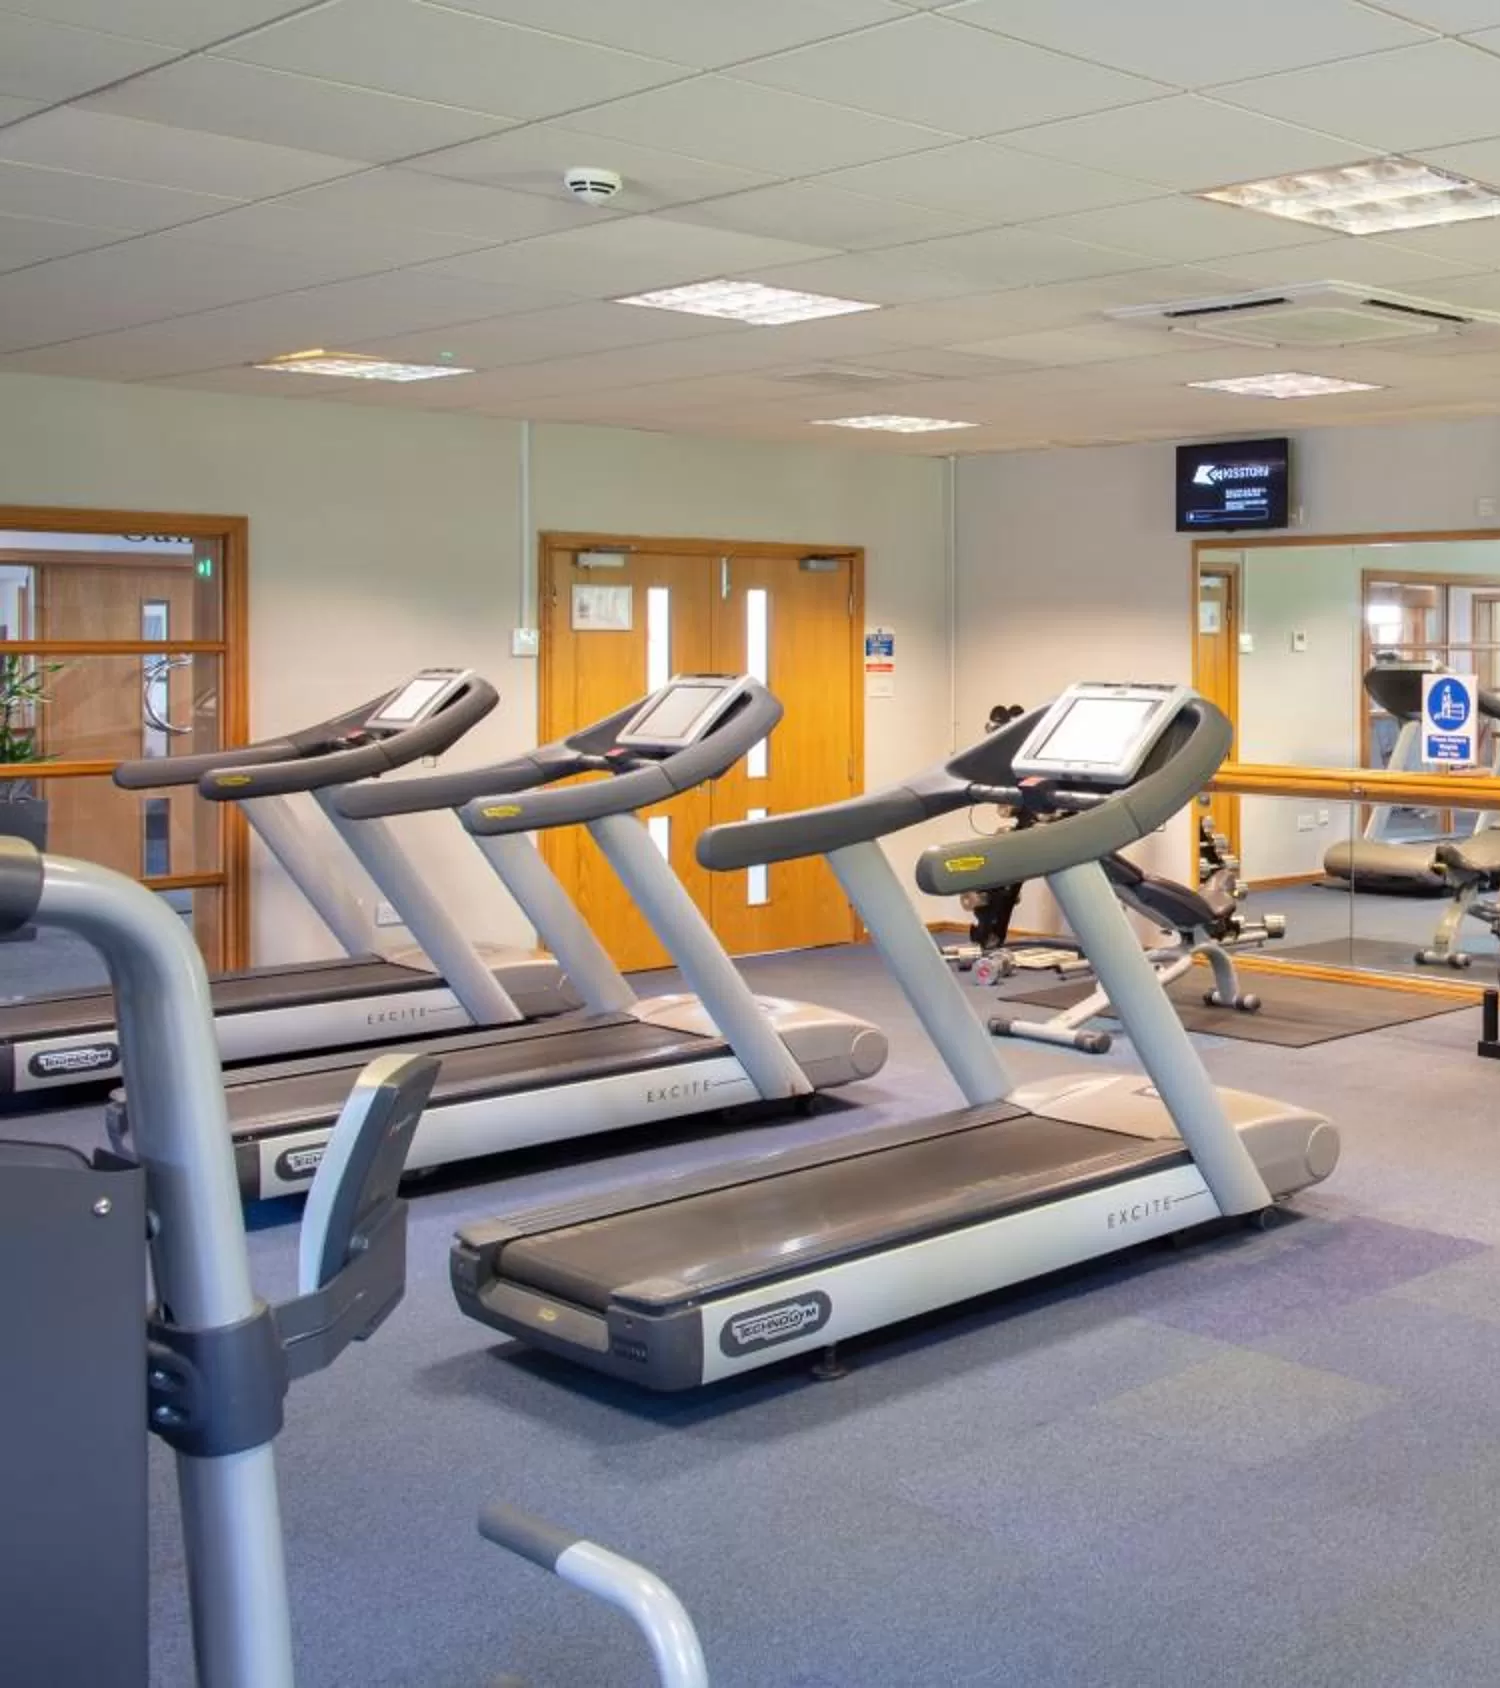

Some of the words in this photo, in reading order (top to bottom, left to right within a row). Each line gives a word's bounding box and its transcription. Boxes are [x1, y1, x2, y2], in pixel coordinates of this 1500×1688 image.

[367, 1007, 426, 1025] EXCITE
[646, 1079, 711, 1104] EXCITE
[1107, 1196, 1171, 1230] EXCITE
[735, 1305, 818, 1339] TECHNOGYM
